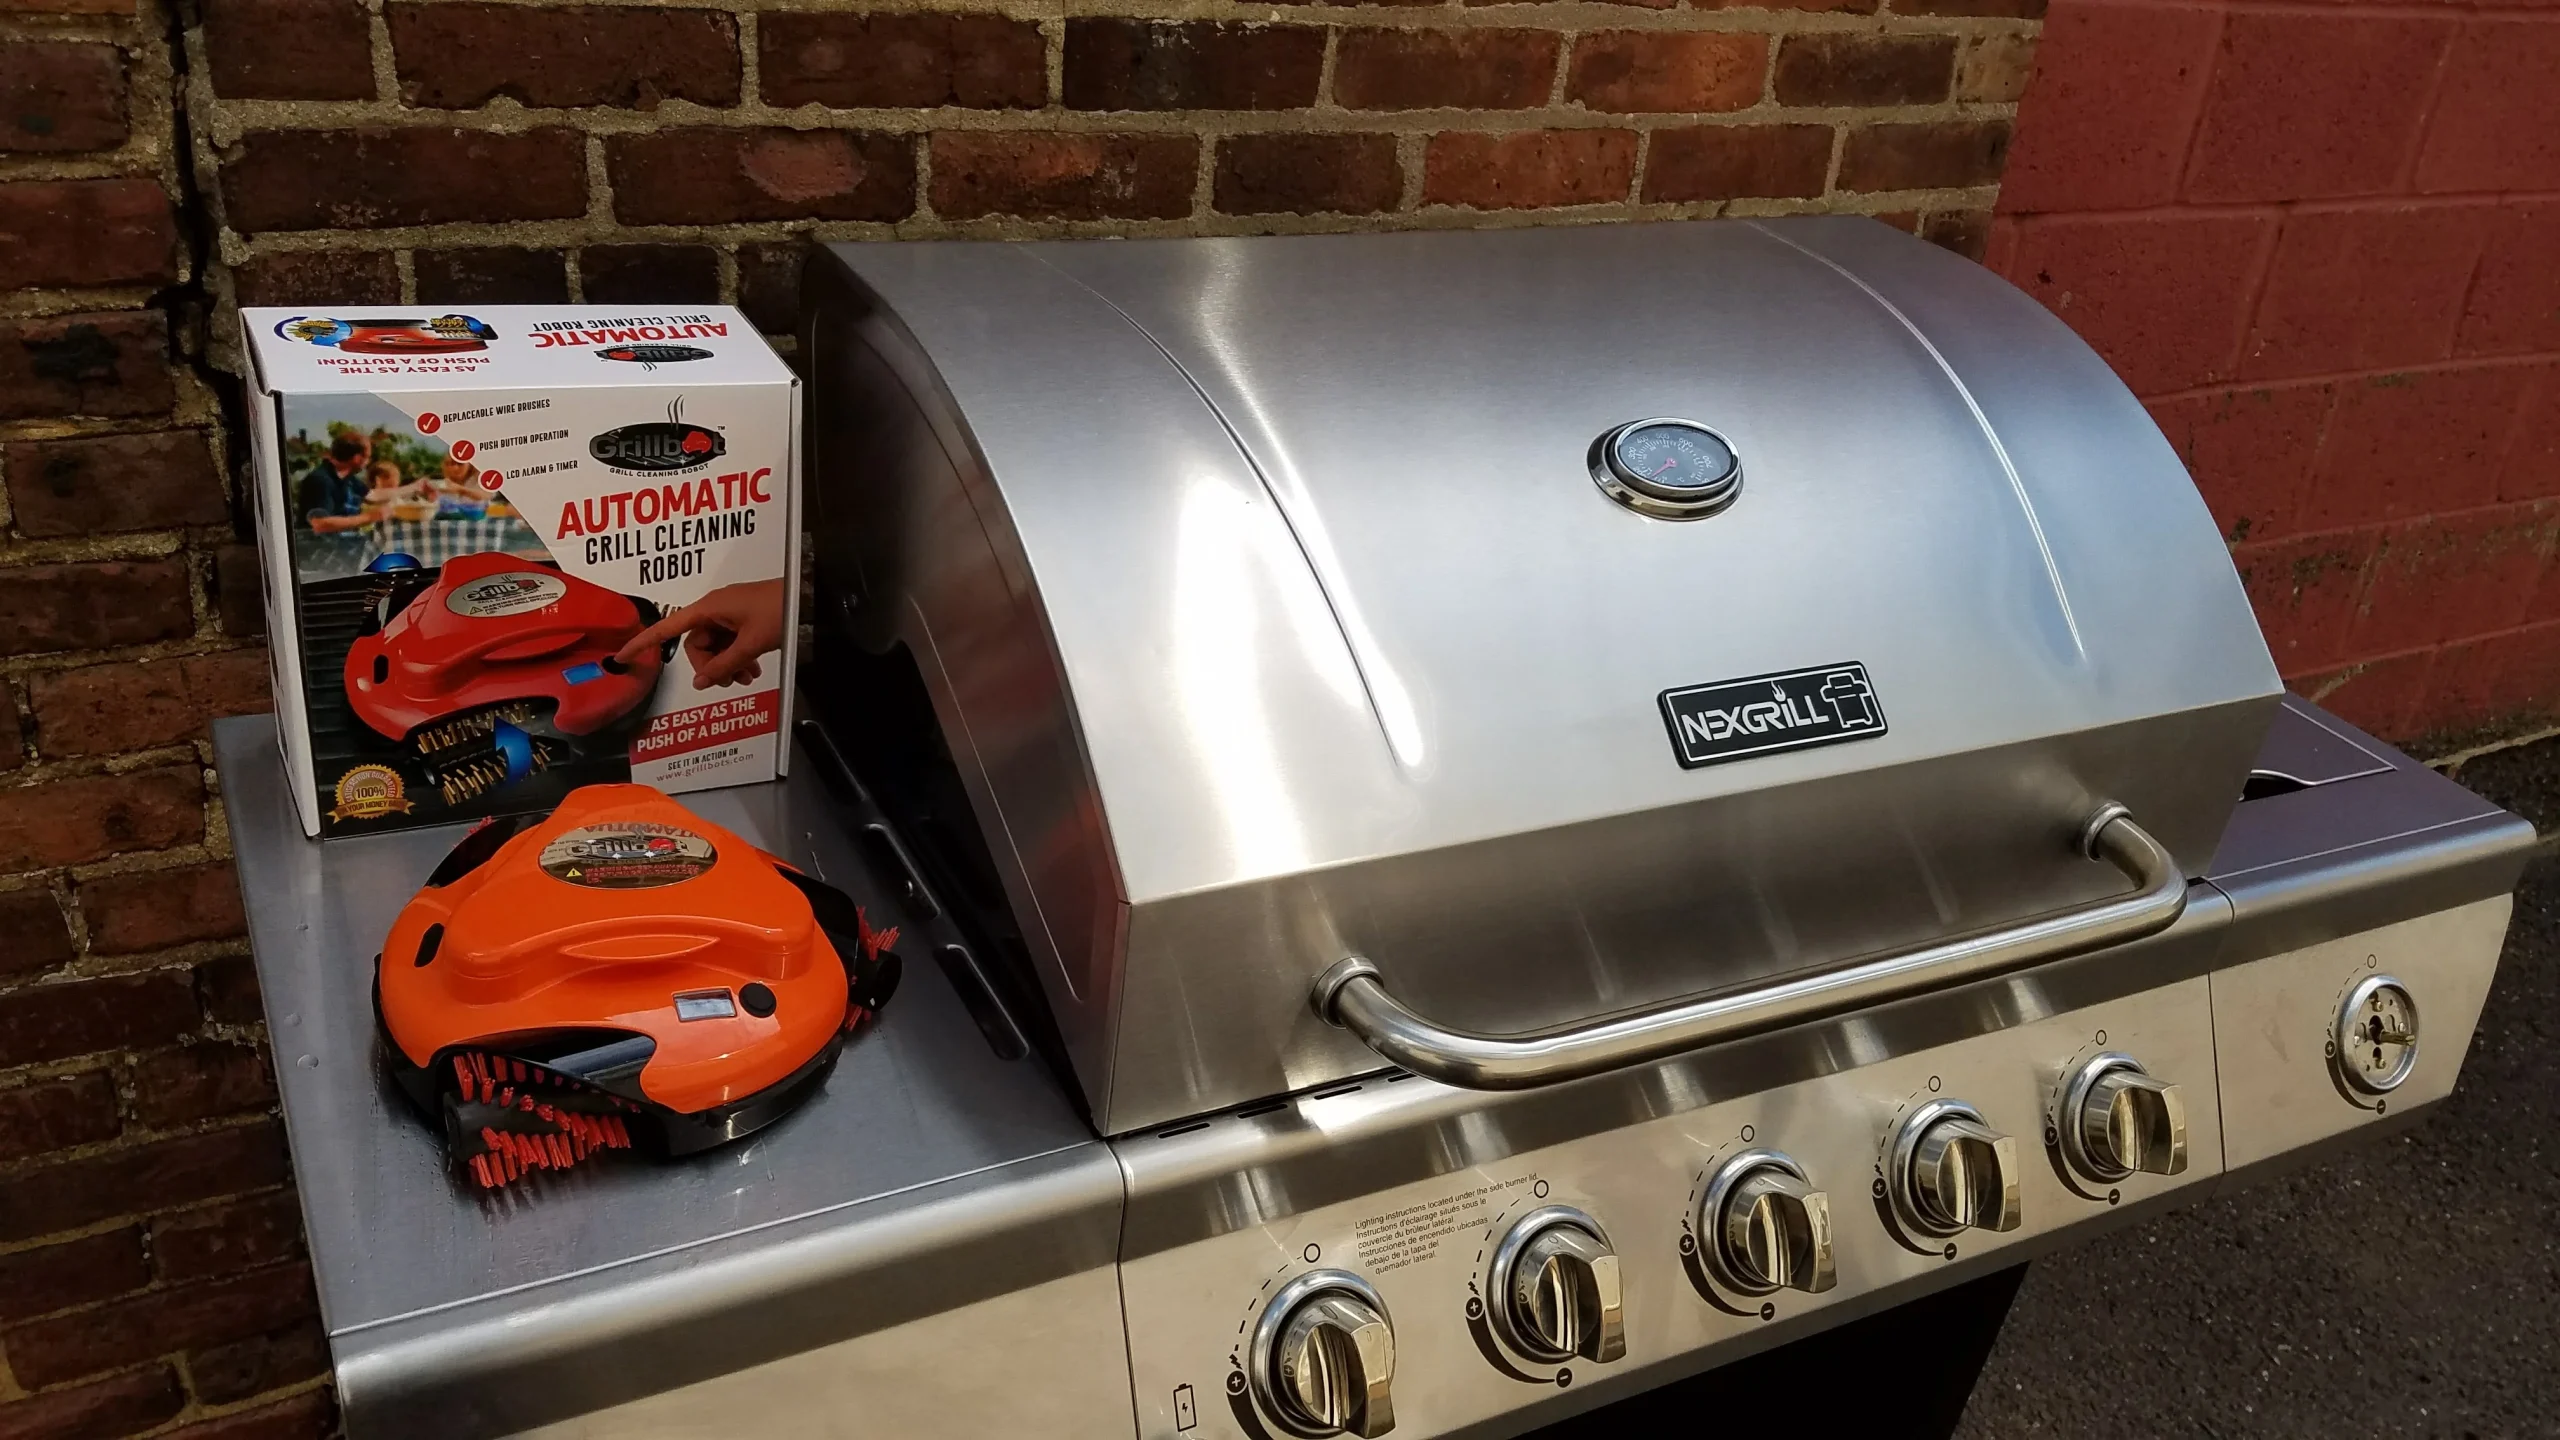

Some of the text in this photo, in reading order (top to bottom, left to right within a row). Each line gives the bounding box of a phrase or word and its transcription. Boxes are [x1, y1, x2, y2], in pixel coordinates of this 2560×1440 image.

[528, 322, 728, 348] AUTOMATIC
[533, 315, 711, 332] GRILL CLEANING ROBOT
[444, 356, 491, 364] PUSH
[443, 399, 551, 424] REPLACEABLE WIRE BRUSHES
[479, 429, 569, 451] PUSH BUTTON OPERATION
[506, 460, 578, 480] LCD ALARM & TIMER
[608, 463, 709, 478] GRILL CLEANING ROBOT
[556, 467, 772, 540] AUTOMATIC
[585, 508, 756, 565] GRILL CLEANING
[639, 548, 706, 586] ROBOT
[651, 697, 756, 732] AS EASY AS THE
[1680, 692, 1830, 744] NEXGRILL
[637, 710, 768, 752] PUSH OF A BUTTON!
[656, 753, 754, 782] www.grillbots.com
[667, 747, 739, 771] SEE IT IN ACTION ON
[355, 785, 385, 799] 100%
[1355, 1172, 1539, 1229] Lighting instructions located under the side burner lid.
[1356, 1197, 1487, 1239] Instructions d'éclairage situés sous le
[1358, 1217, 1488, 1258] Instrucciones de encendido ubicadas
[1358, 1233, 1393, 1249] couvercle
[1394, 1230, 1404, 1239] du
[1365, 1240, 1440, 1268] debajo de la tapa del
[1375, 1258, 1412, 1276] quemador
